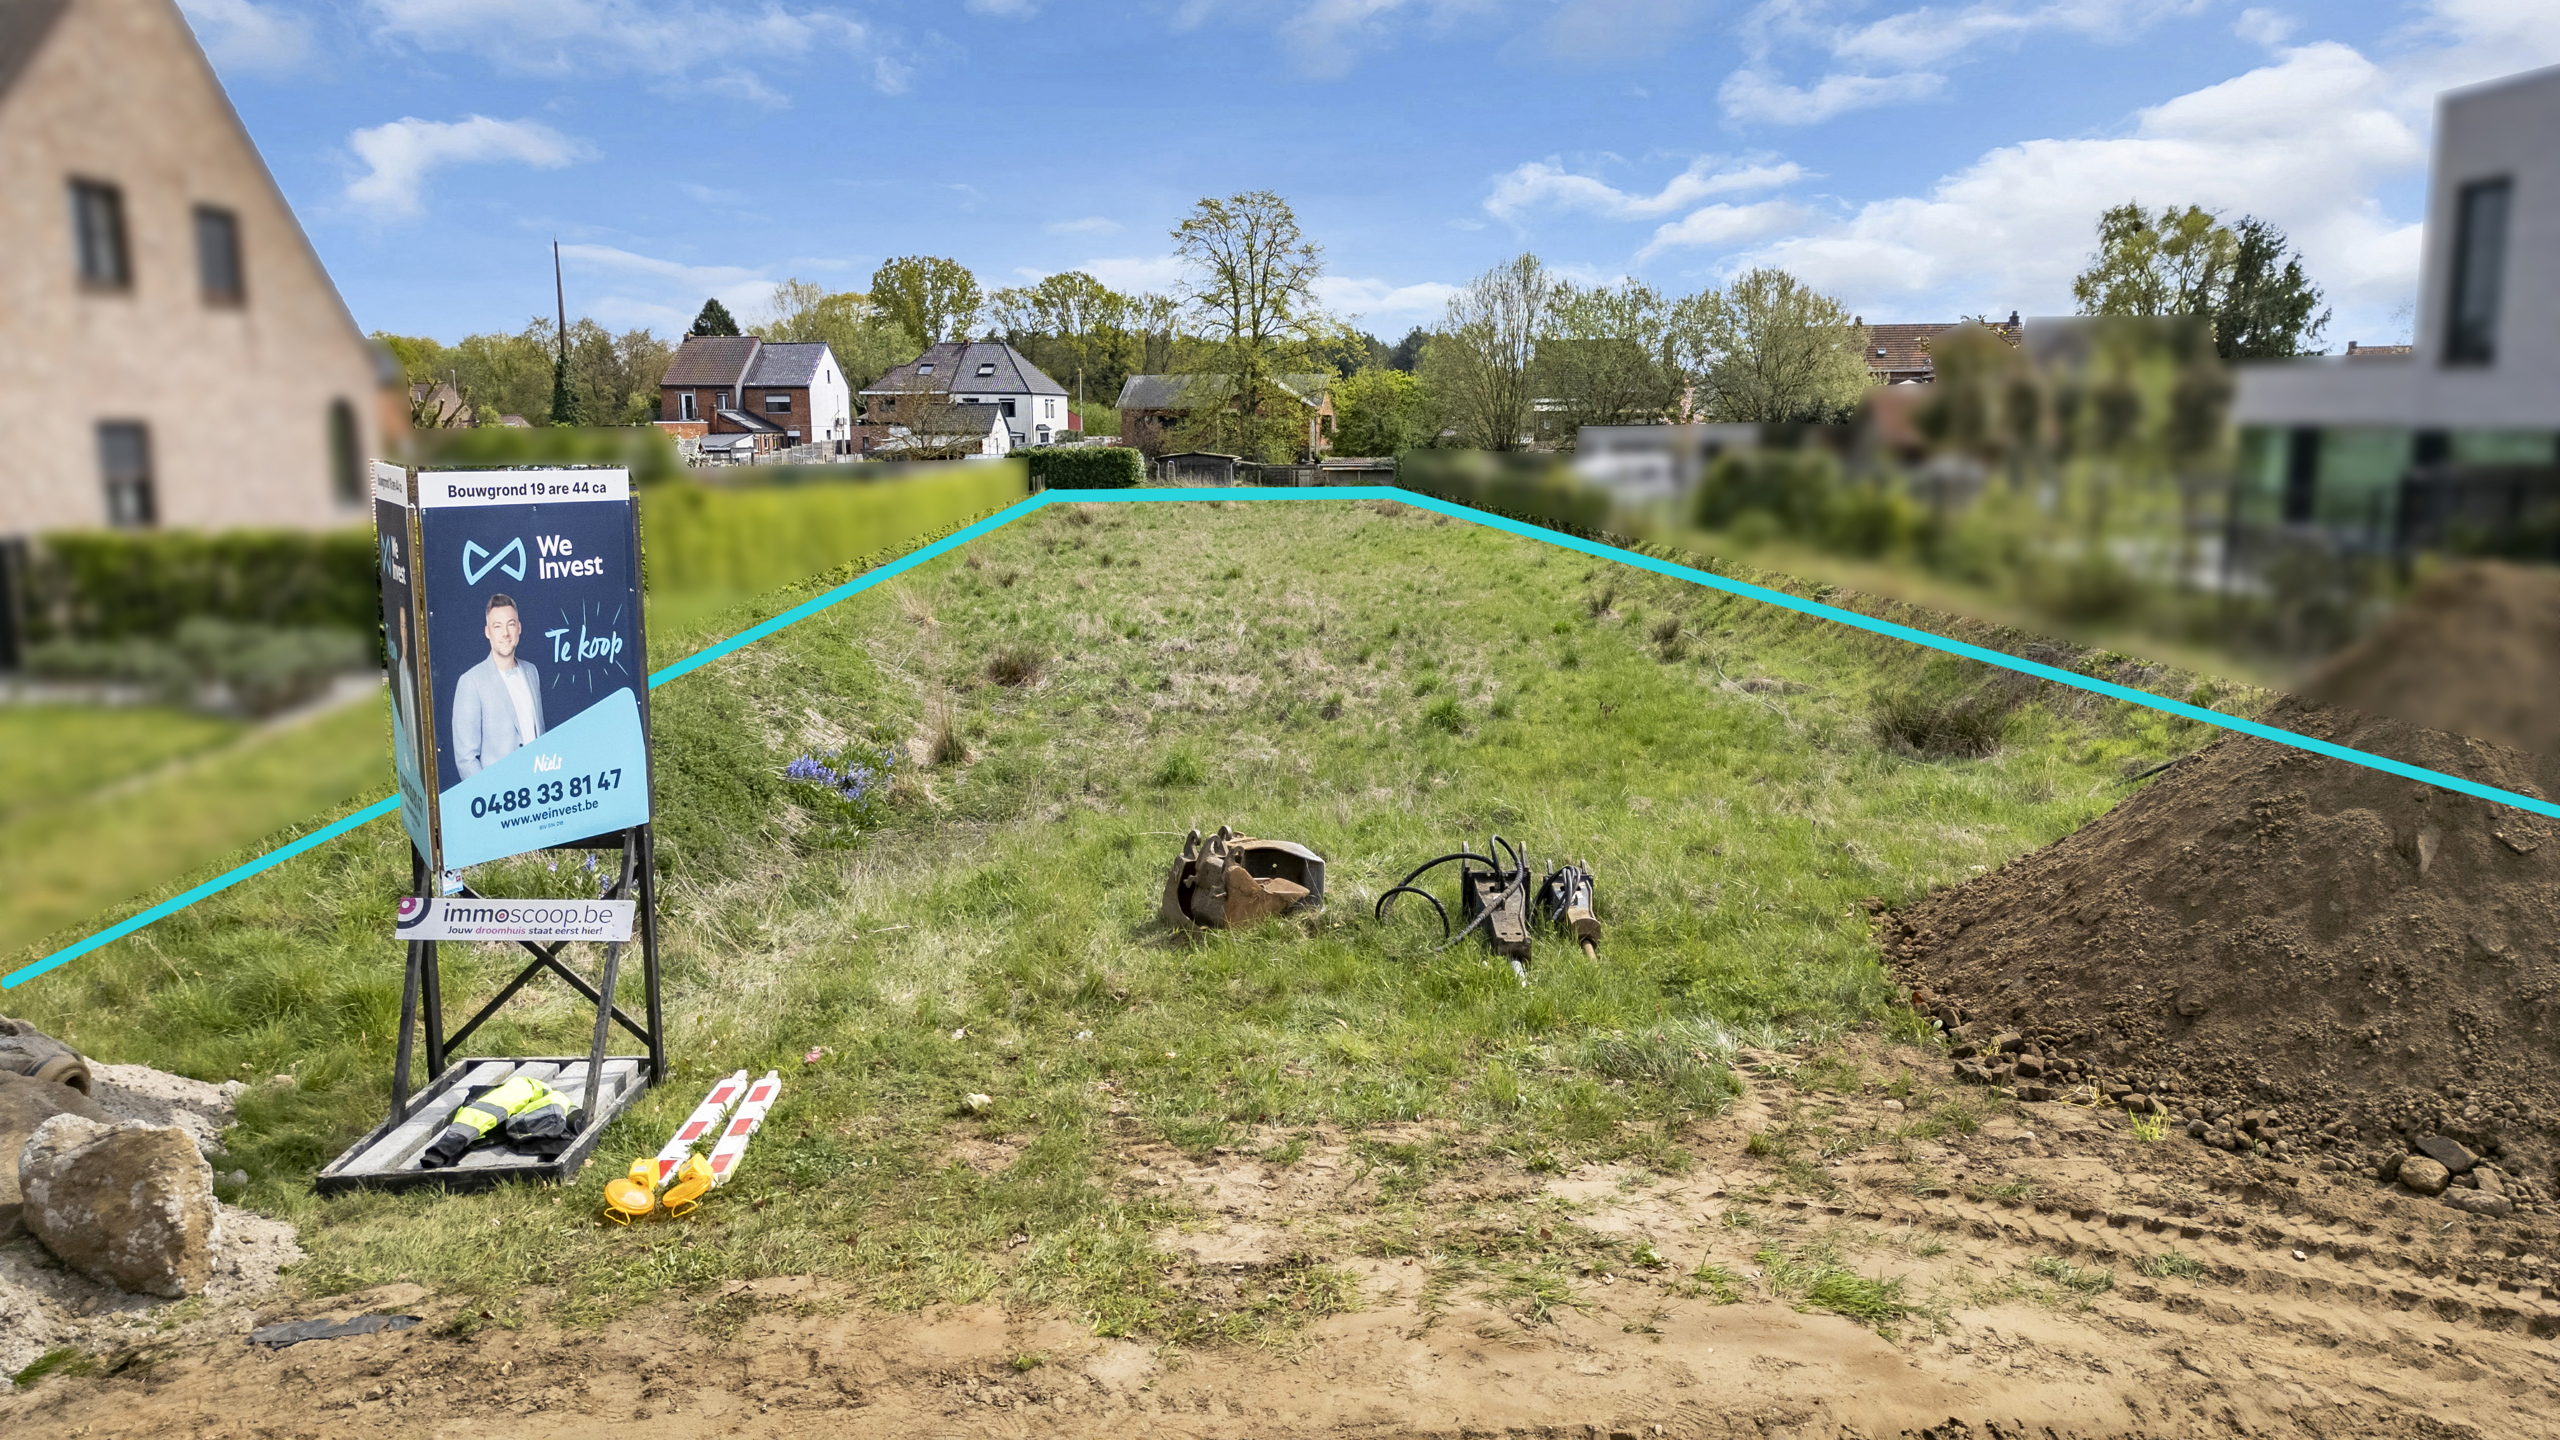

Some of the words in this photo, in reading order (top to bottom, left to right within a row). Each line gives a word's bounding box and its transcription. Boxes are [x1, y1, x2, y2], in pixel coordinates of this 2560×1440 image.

[448, 483, 527, 500] Bouwgrond
[530, 483, 545, 495] 19
[549, 484, 569, 495] are
[573, 482, 589, 494] 44
[593, 484, 607, 494] ca
[536, 534, 573, 557] We
[539, 556, 604, 579] Invest
[545, 628, 572, 663] Te
[577, 624, 623, 664] koop
[533, 753, 562, 773] Niels
[470, 787, 532, 818] 0488
[537, 780, 564, 805] 33
[569, 774, 592, 798] 81
[597, 768, 622, 791] 47
[500, 798, 599, 829] www.weinvest.be
[443, 902, 613, 927] immoscoop.be
[447, 926, 473, 935] Jouw
[475, 926, 526, 935] droomhuis
[528, 926, 553, 935] staat
[555, 926, 579, 935] eerst
[581, 926, 603, 935] hier!
